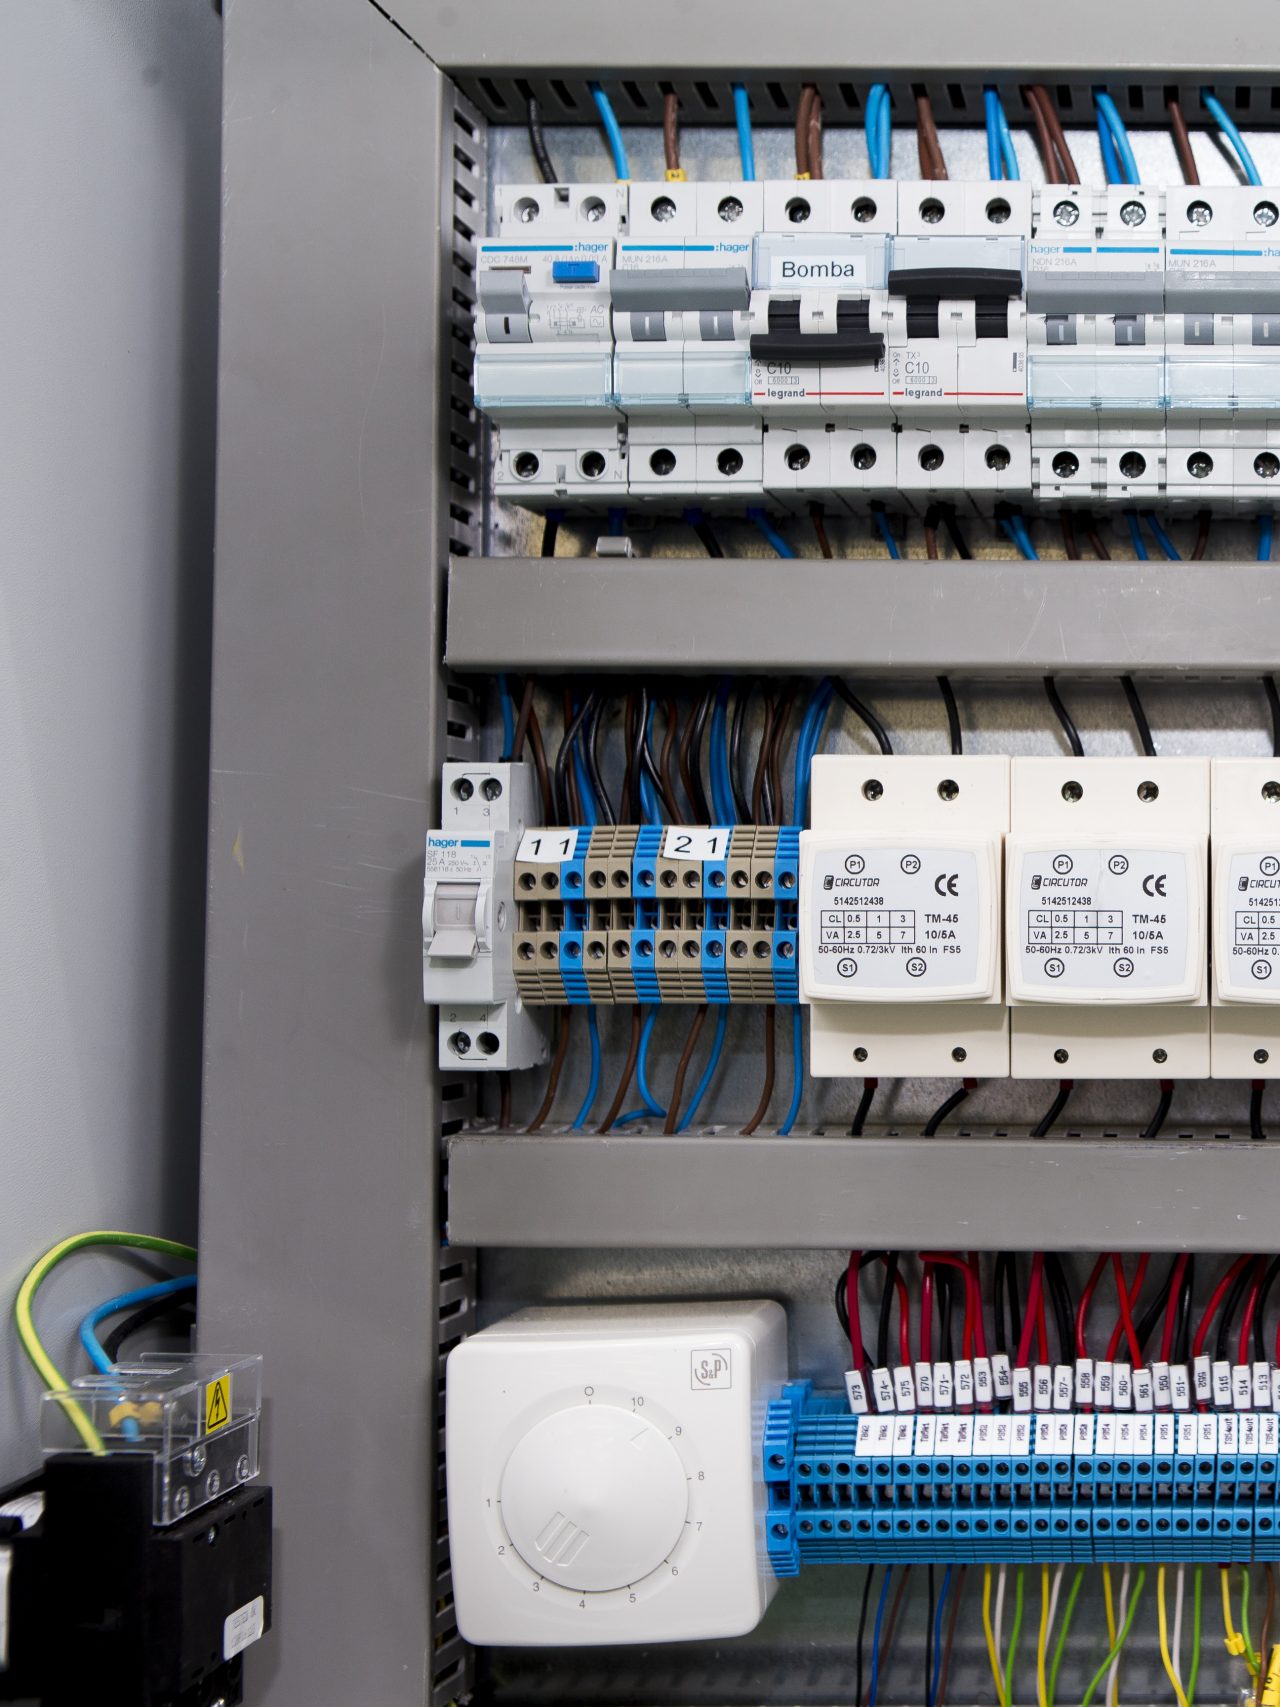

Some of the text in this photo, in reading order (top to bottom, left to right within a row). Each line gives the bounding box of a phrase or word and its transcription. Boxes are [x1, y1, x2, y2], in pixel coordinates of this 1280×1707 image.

[1031, 245, 1060, 254] hager
[1056, 258, 1077, 266] 216A
[1169, 260, 1215, 268] MUN 216A
[782, 261, 854, 277] Bomba
[767, 362, 791, 374] C10
[905, 362, 929, 374] C10
[768, 388, 805, 398] legrand
[905, 388, 942, 397] legrand
[428, 837, 459, 849] hager
[427, 850, 457, 858] SF 118
[850, 861, 861, 869] P1
[906, 861, 917, 869] P2
[1058, 861, 1069, 869] P1
[835, 878, 880, 887] CIRCUTOR
[1043, 878, 1087, 887] CIRCUTOR
[834, 897, 884, 905] 5142512438
[1042, 897, 1091, 905] 5142512438
[925, 914, 958, 923] TM-45
[1133, 914, 1166, 923] TM-45
[925, 930, 956, 939] 10/5A
[1133, 931, 1163, 940] 10/5A
[818, 946, 895, 954] 50-60Hz 0.72/3kV
[1025, 946, 1103, 954] 50-60Hz 0.72/3kV
[1233, 947, 1269, 955] 50-60Hz
[1050, 964, 1060, 972] S1
[632, 1397, 643, 1406] 10
[675, 1427, 681, 1436] 9
[698, 1472, 704, 1481] 8
[486, 1499, 491, 1507] 1
[696, 1522, 702, 1531] 7
[498, 1546, 505, 1555] 2
[672, 1567, 678, 1576] 6
[533, 1582, 540, 1591] 3
[630, 1594, 636, 1603] 5
[579, 1600, 585, 1609] 4
